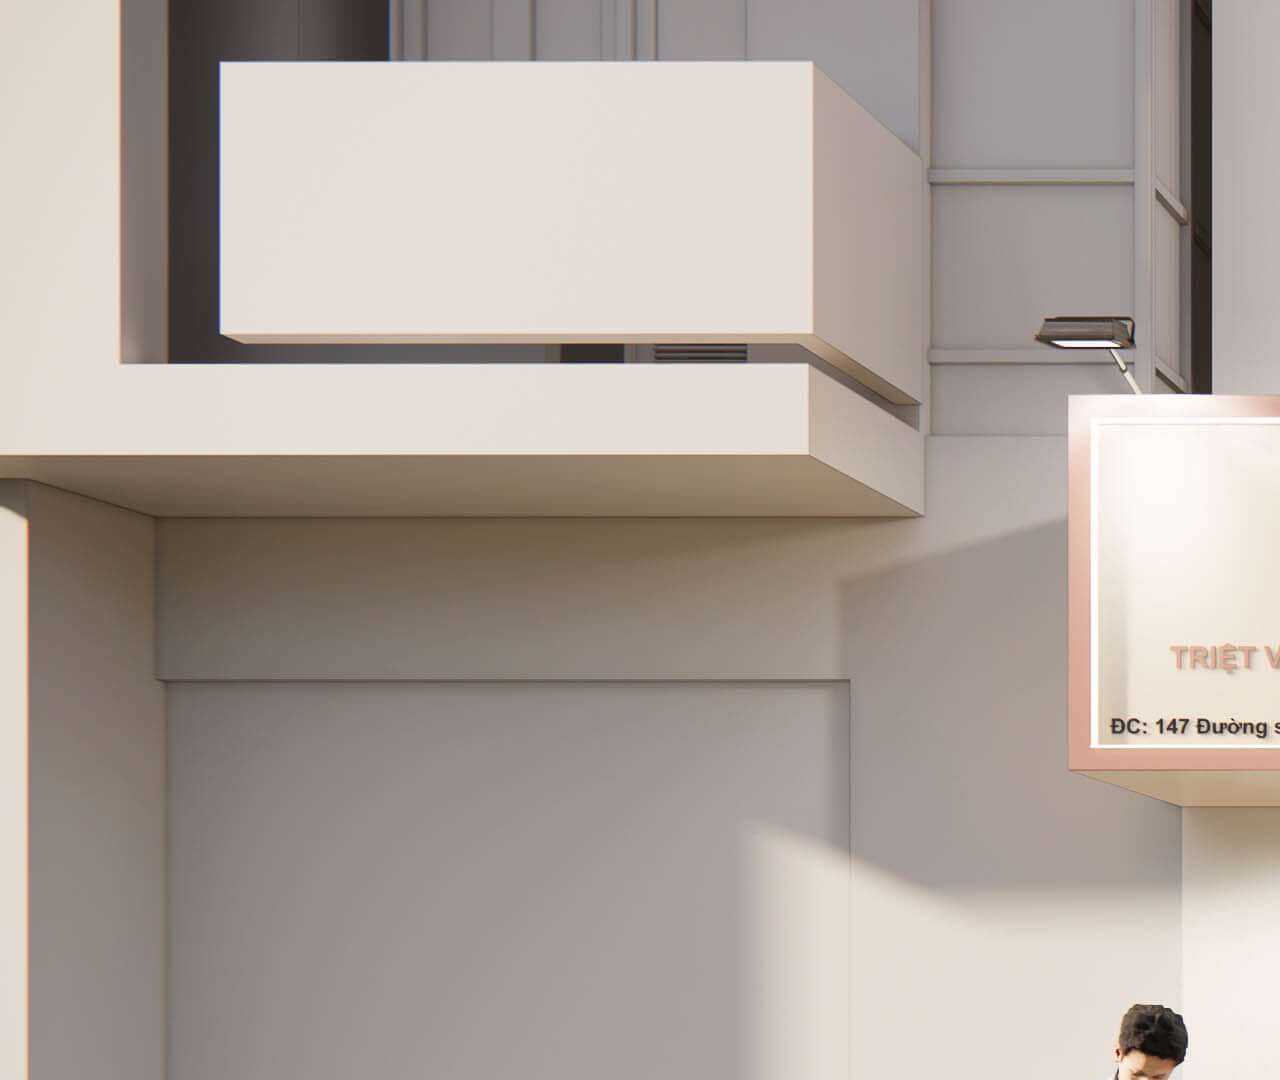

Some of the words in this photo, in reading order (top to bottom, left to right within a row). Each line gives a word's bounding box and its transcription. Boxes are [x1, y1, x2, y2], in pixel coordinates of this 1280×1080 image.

[1170, 643, 1257, 674] TRIỆT
[1110, 718, 1148, 735] ĐC:
[1155, 718, 1190, 734] 147
[1196, 718, 1268, 739] Đường
